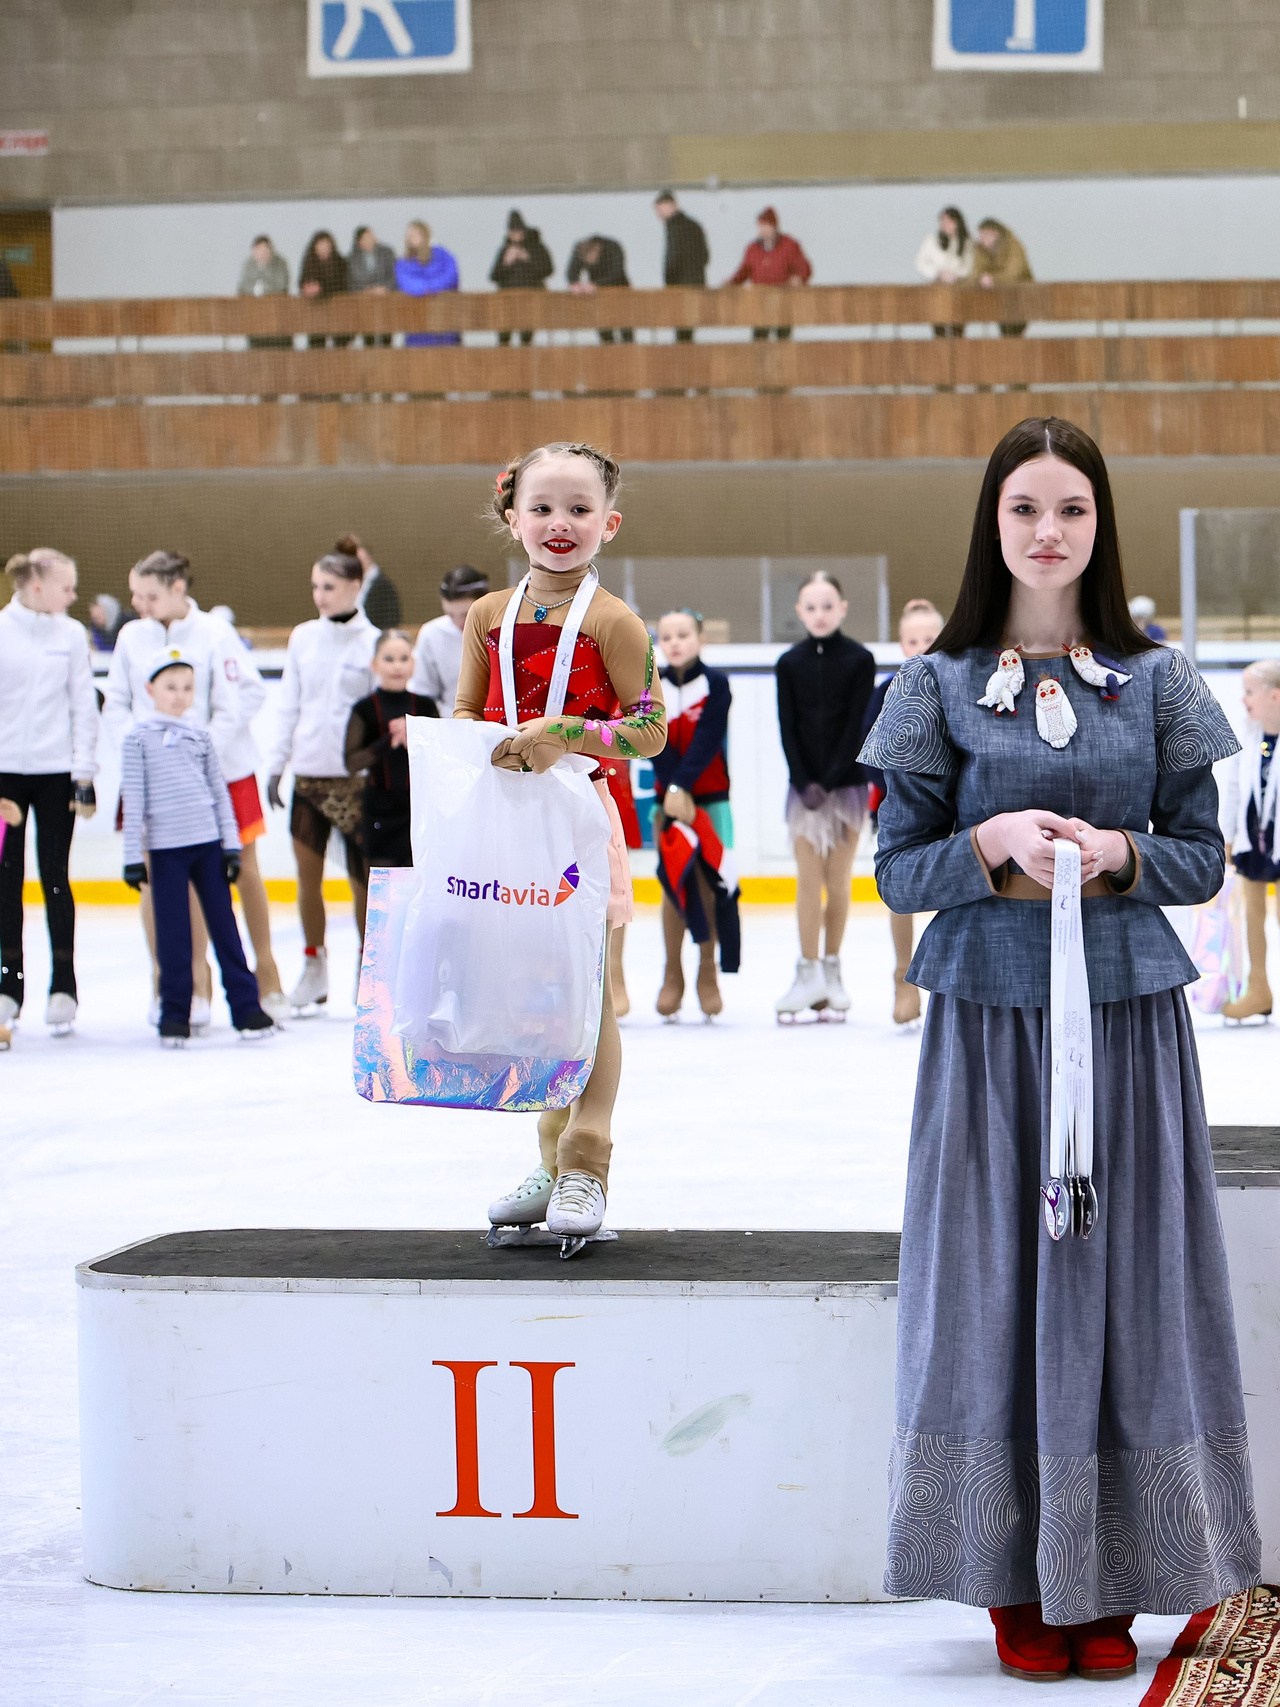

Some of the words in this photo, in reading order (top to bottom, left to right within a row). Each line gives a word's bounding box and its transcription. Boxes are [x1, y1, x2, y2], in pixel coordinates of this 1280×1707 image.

[1056, 858, 1064, 886] CANDY
[1064, 858, 1072, 886] КУБОК
[447, 875, 550, 906] smartavia
[432, 1360, 579, 1519] II
